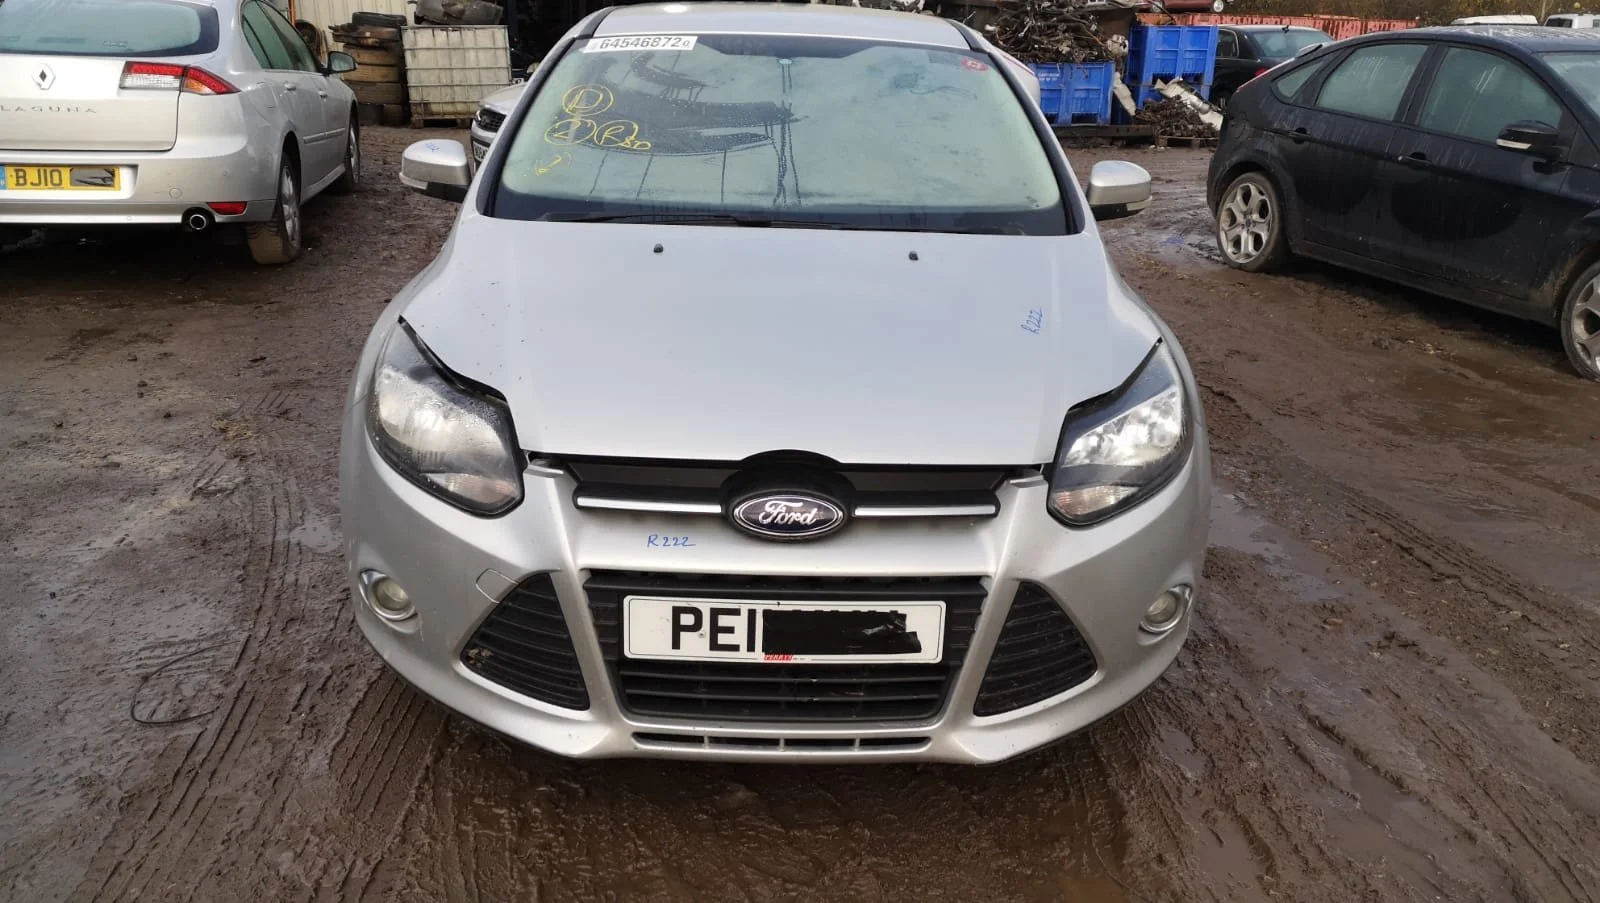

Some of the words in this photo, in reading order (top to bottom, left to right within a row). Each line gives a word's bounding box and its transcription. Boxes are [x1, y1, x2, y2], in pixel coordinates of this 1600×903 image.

[0, 104, 97, 114] LAGUNA
[14, 168, 62, 187] BJ10
[758, 500, 821, 526] Ford
[646, 534, 697, 548] R222
